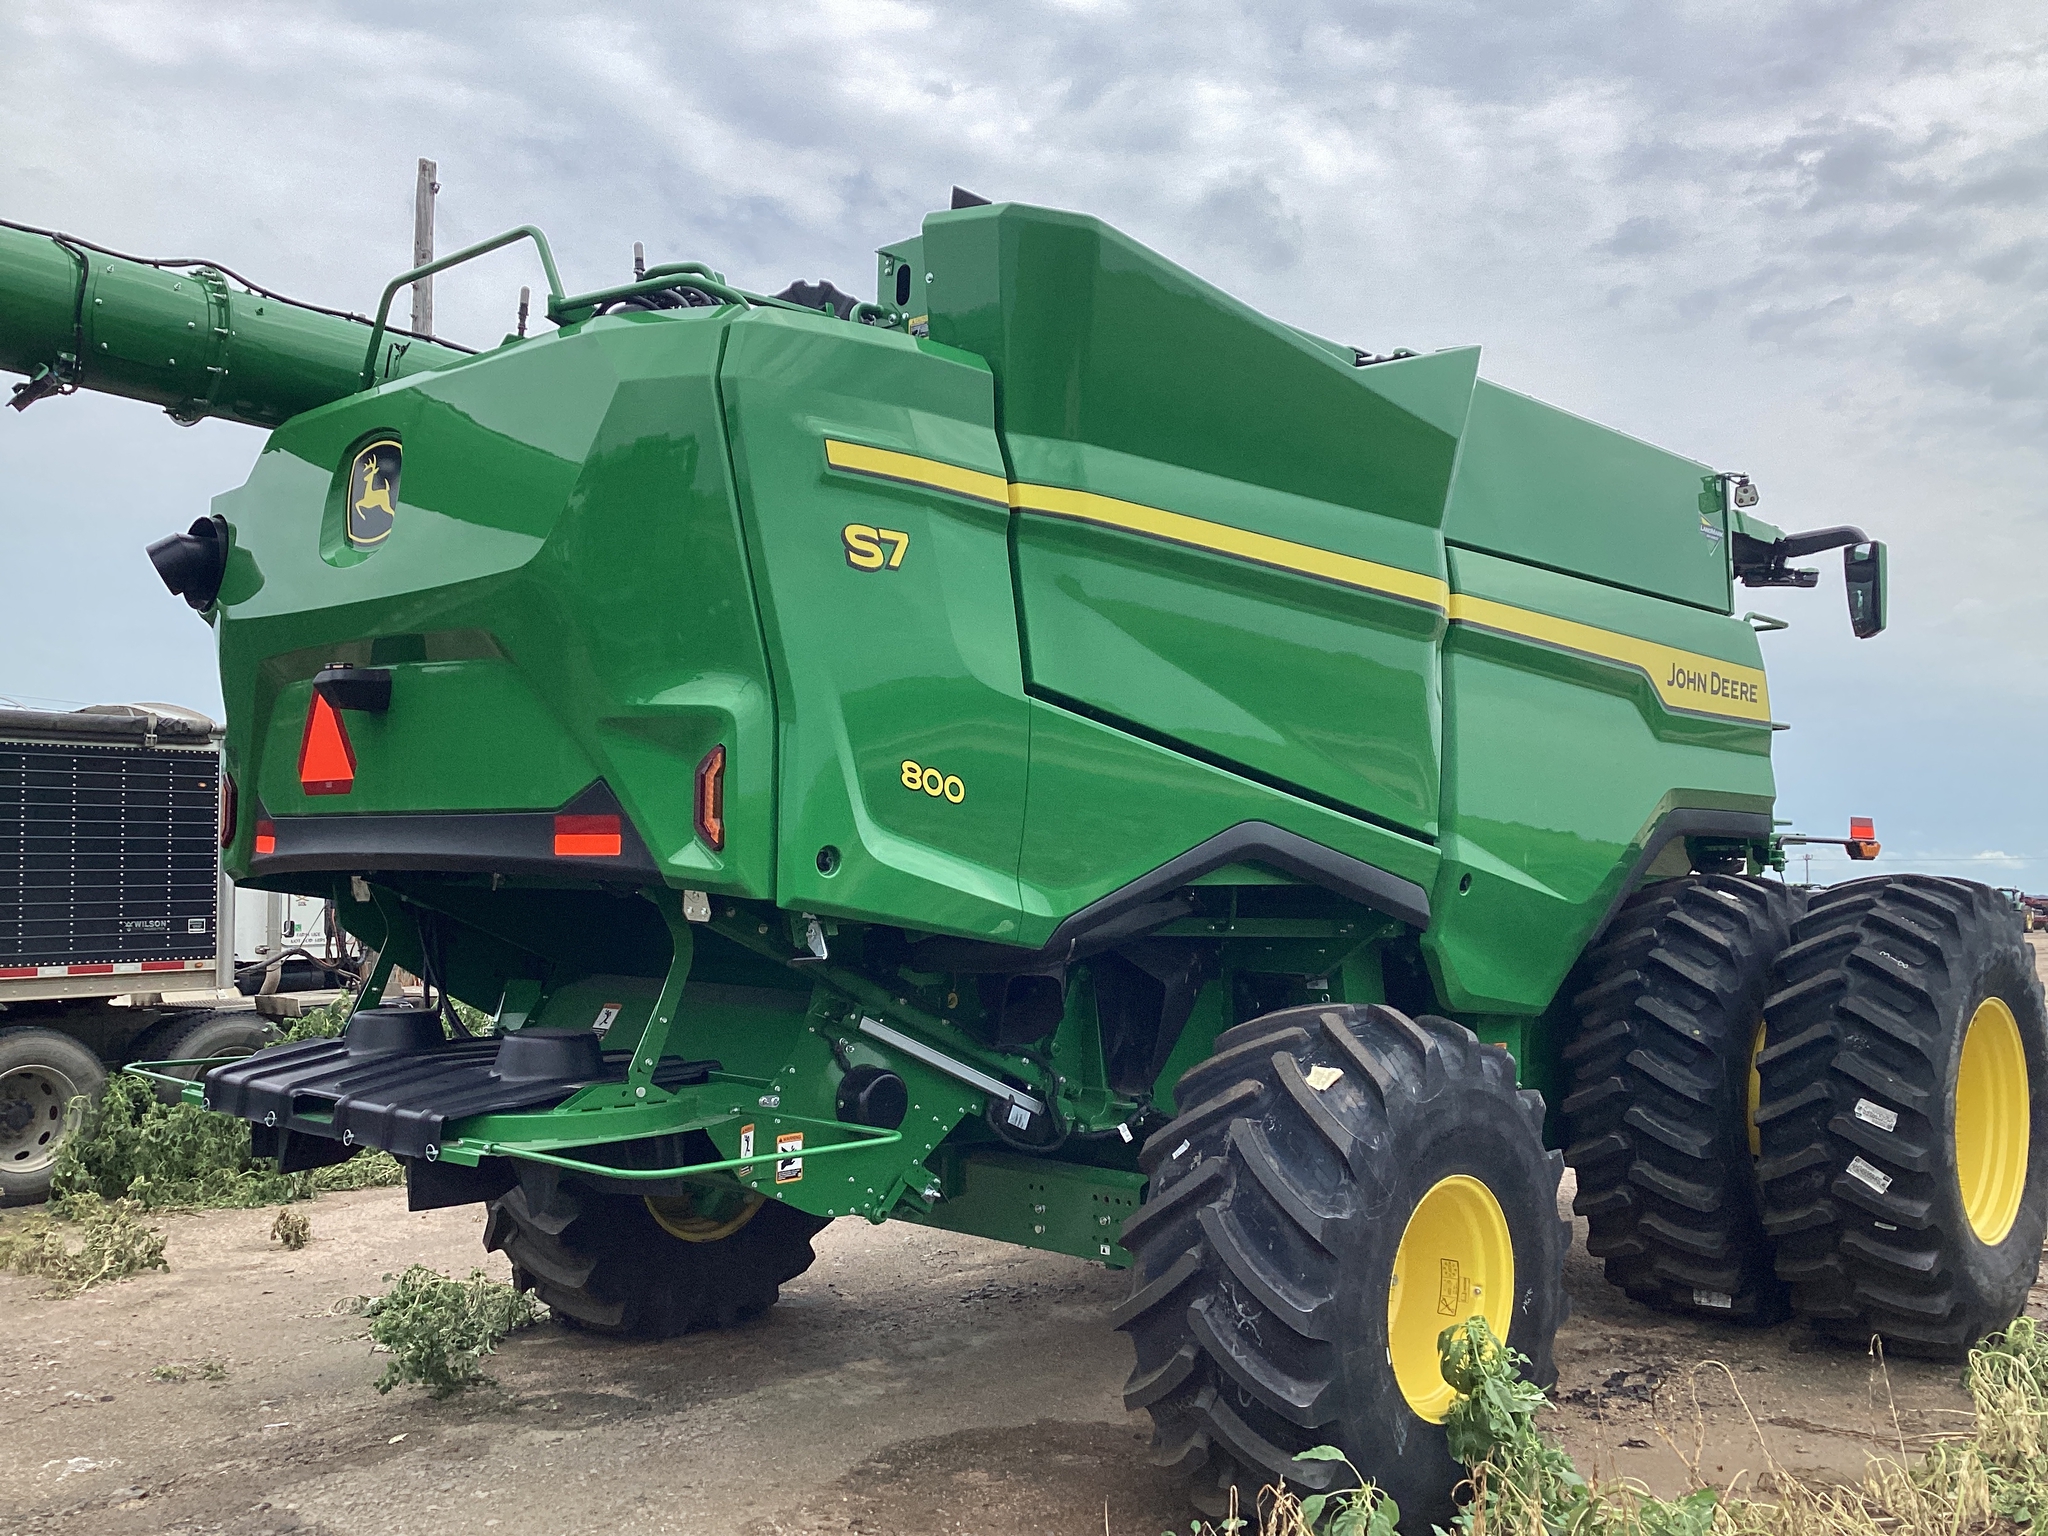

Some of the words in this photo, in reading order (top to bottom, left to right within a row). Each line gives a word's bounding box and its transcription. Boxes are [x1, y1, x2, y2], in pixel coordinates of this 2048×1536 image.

[841, 523, 910, 573] S7
[1667, 662, 1707, 694] JOHN
[1710, 671, 1758, 703] DEERE
[900, 759, 966, 804] 800
[134, 920, 167, 928] WILSON
